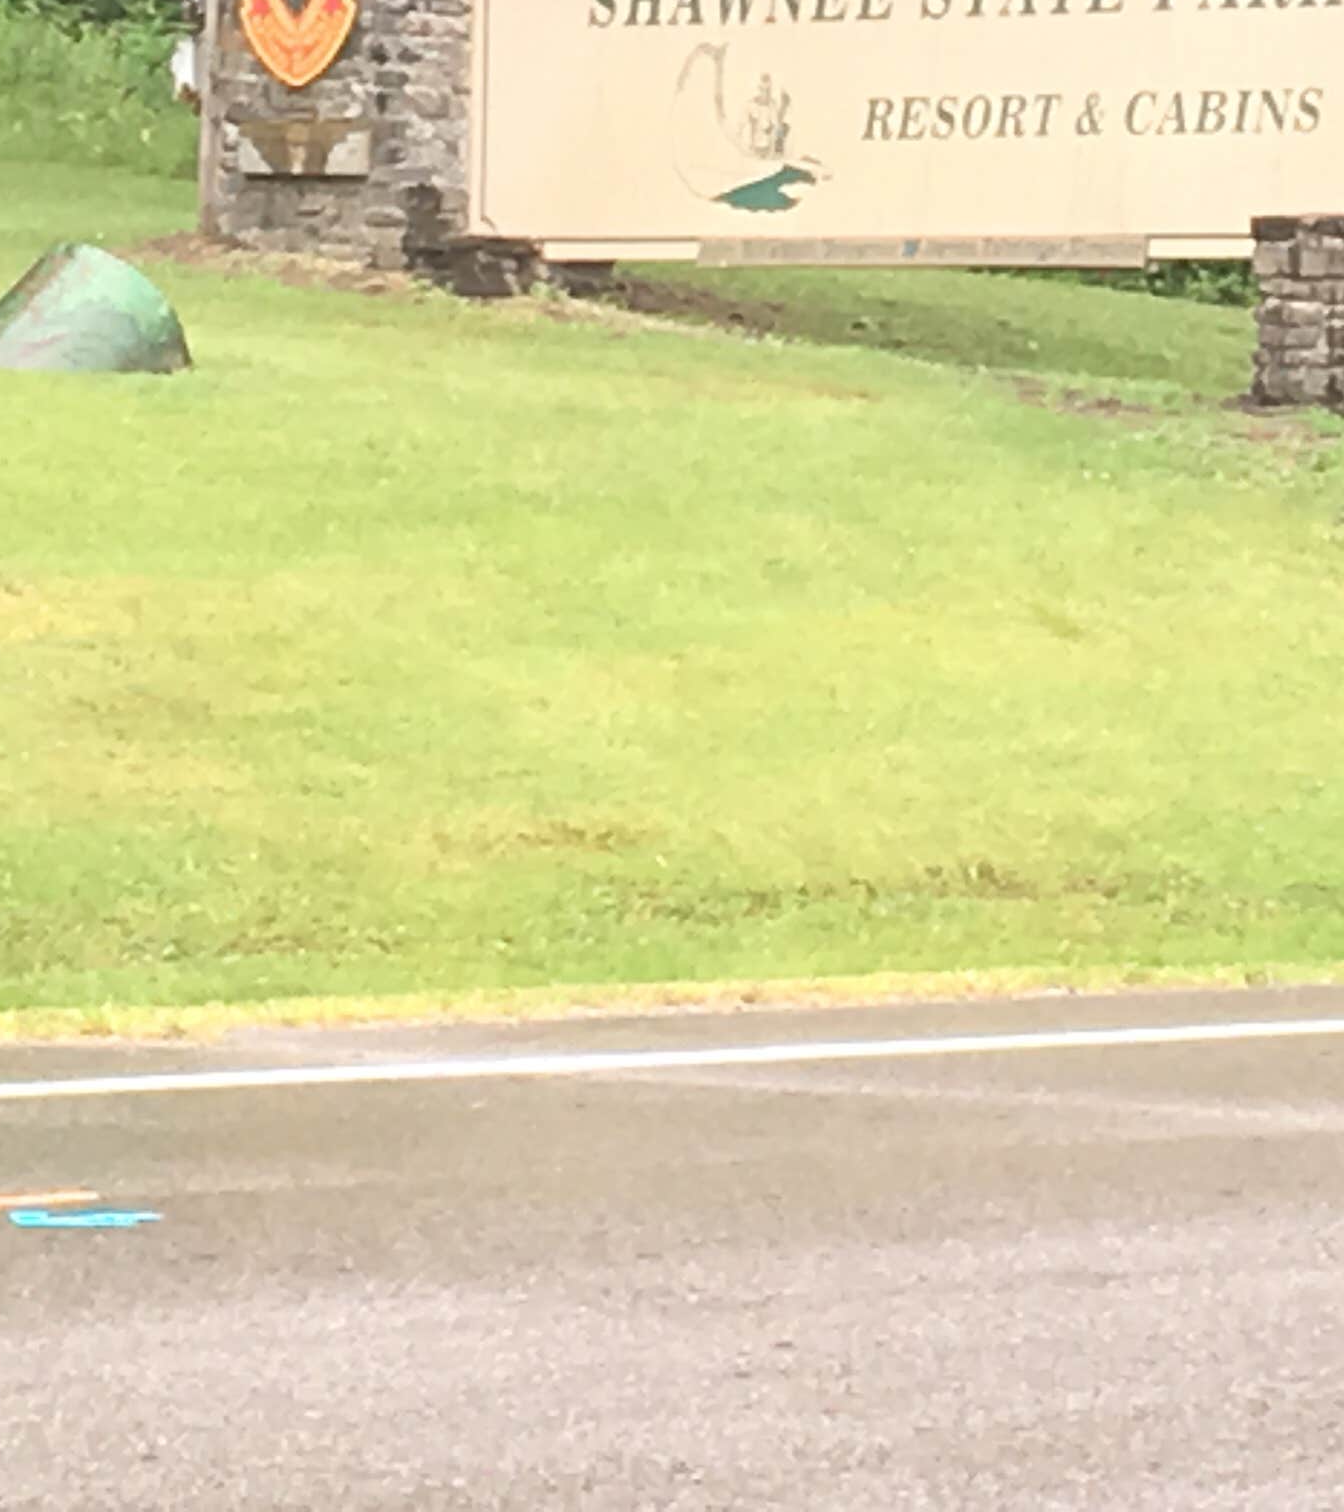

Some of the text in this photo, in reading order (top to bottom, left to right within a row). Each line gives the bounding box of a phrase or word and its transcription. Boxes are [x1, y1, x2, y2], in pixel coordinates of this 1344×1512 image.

[862, 86, 1324, 142] RESORT & CABINS
